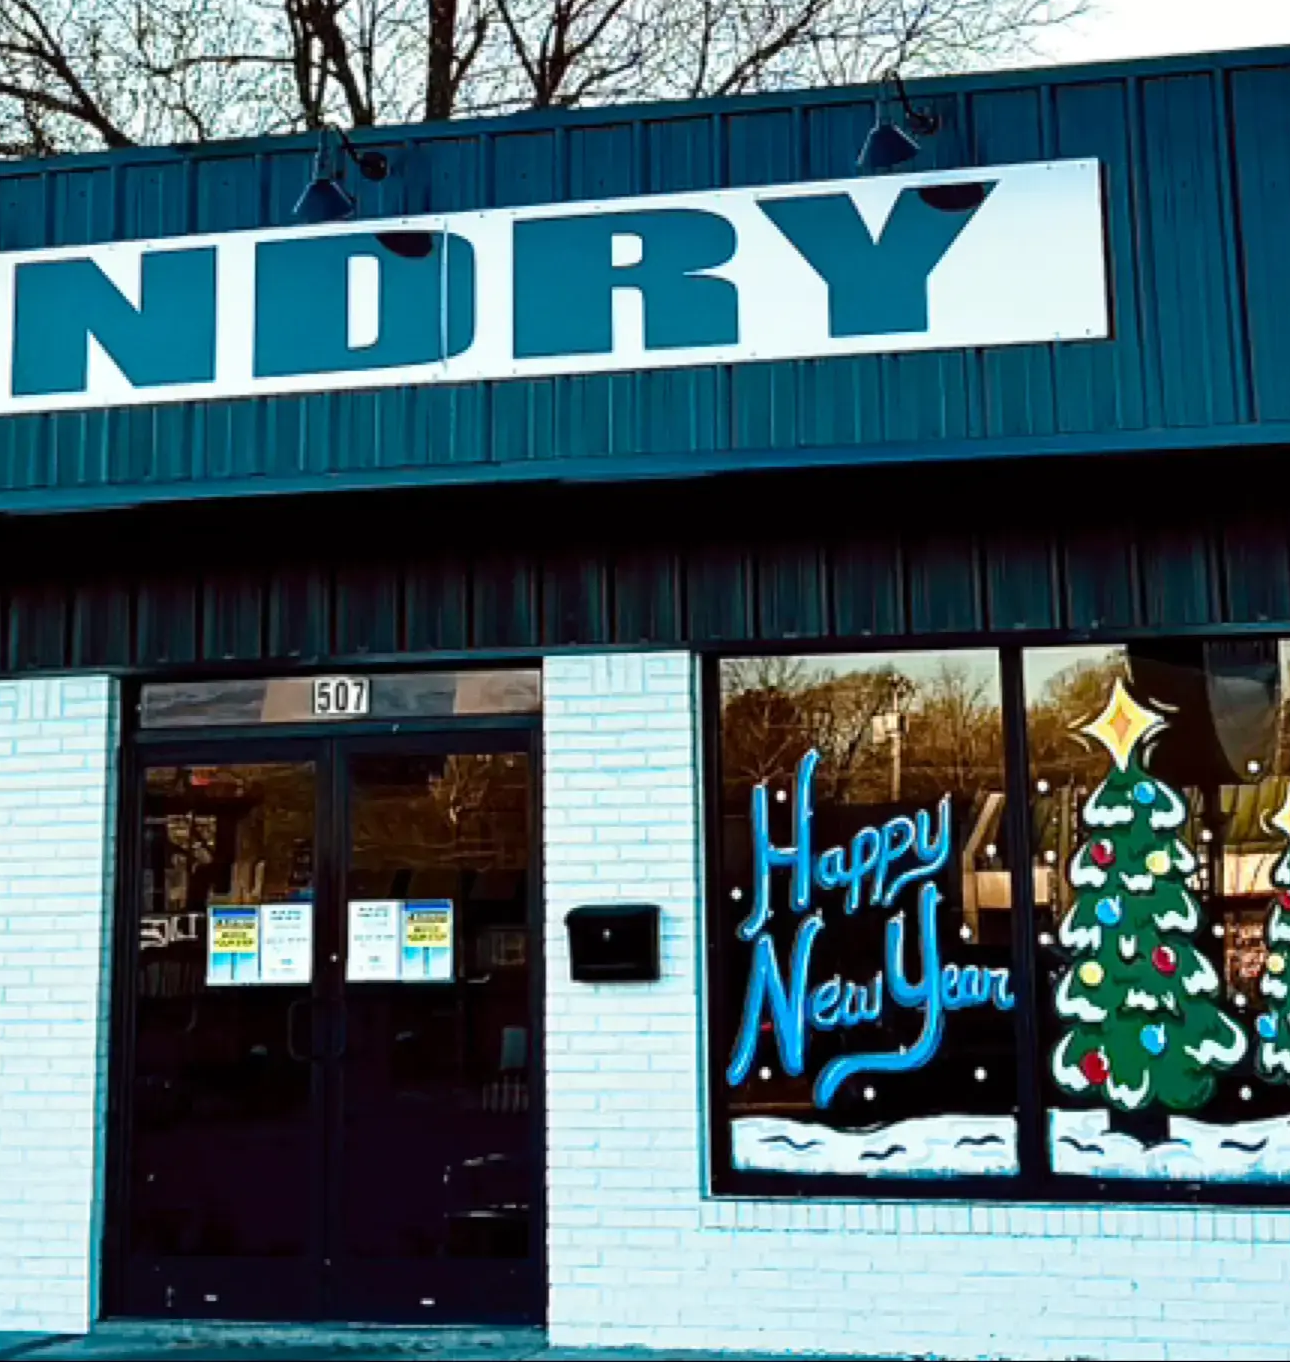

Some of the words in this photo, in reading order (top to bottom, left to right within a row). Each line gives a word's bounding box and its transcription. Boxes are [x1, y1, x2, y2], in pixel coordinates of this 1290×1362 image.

[317, 682, 365, 711] 507
[738, 749, 952, 940] Happy
[726, 910, 883, 1087] New
[814, 881, 1015, 1109] Year
